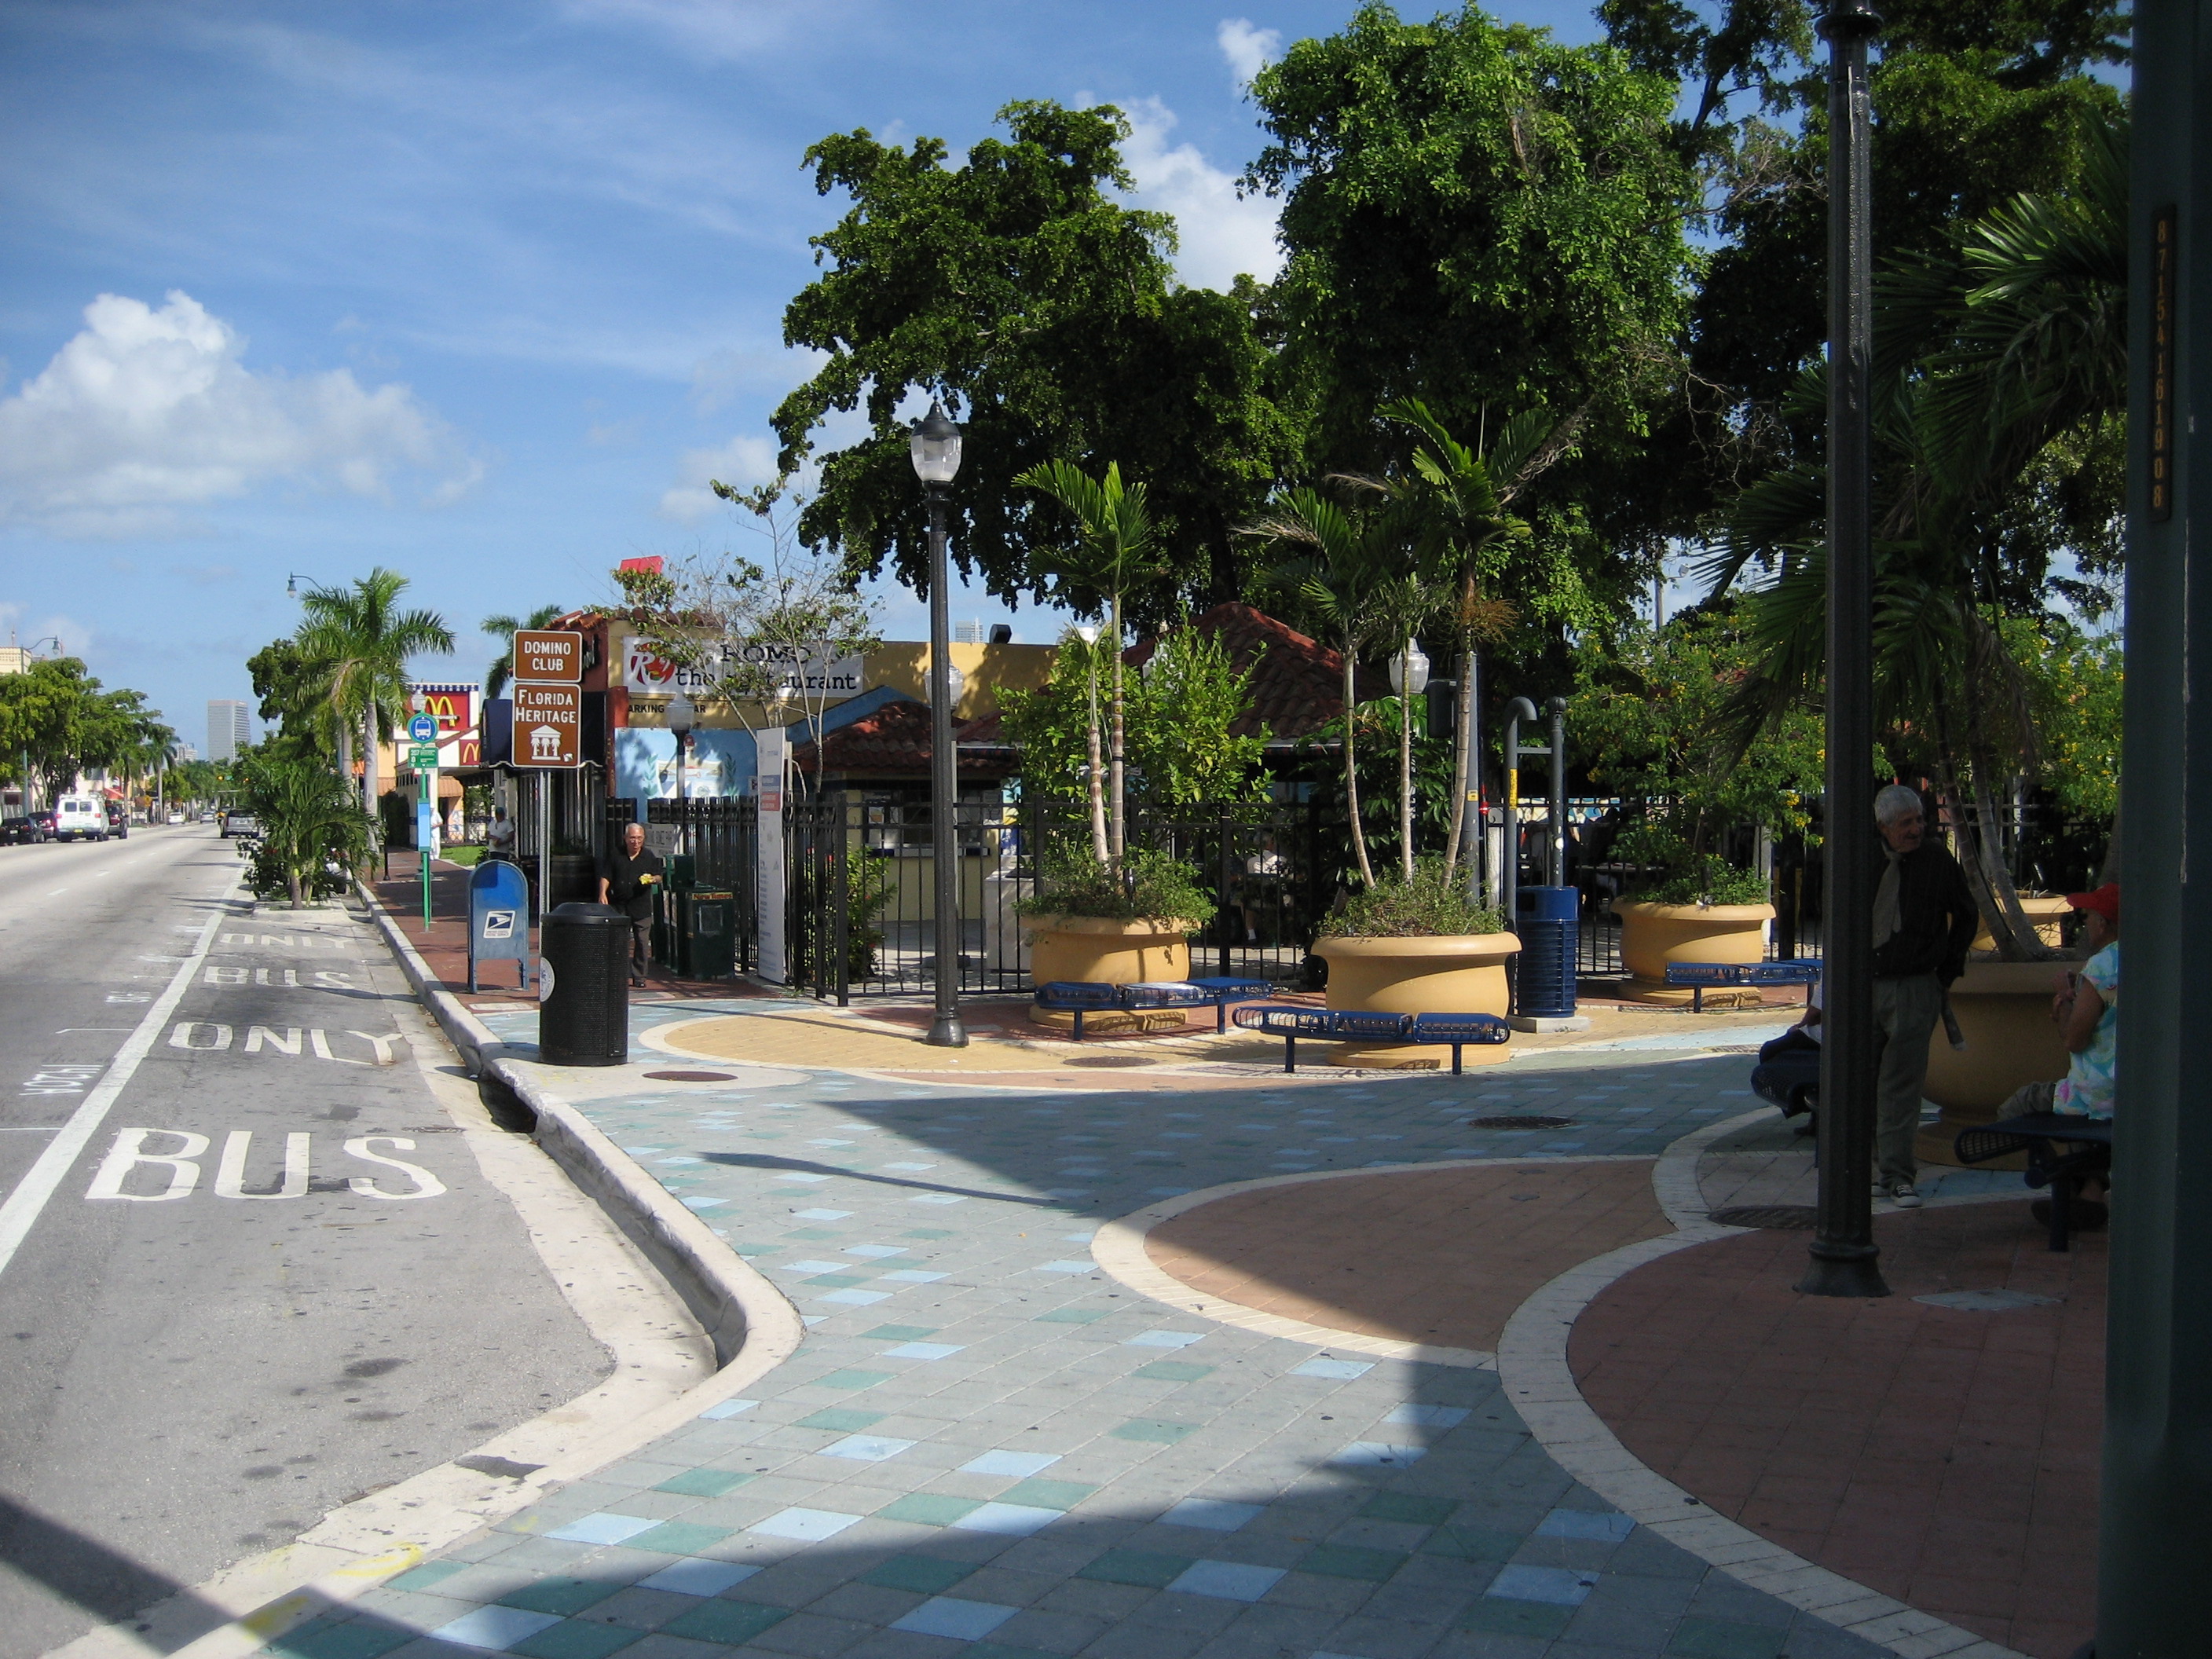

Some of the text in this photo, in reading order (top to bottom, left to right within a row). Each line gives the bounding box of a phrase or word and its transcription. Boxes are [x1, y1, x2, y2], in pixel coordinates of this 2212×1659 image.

[524, 641, 571, 655] DOMINO
[532, 657, 564, 672] CLUB
[518, 689, 573, 706] FLORIDA
[515, 707, 577, 723] HERITAGE
[628, 705, 665, 713] ARKING
[219, 932, 355, 949] ONLY
[203, 966, 355, 990] BUS
[167, 1021, 403, 1066] ONLY
[84, 1126, 448, 1202] BUS
